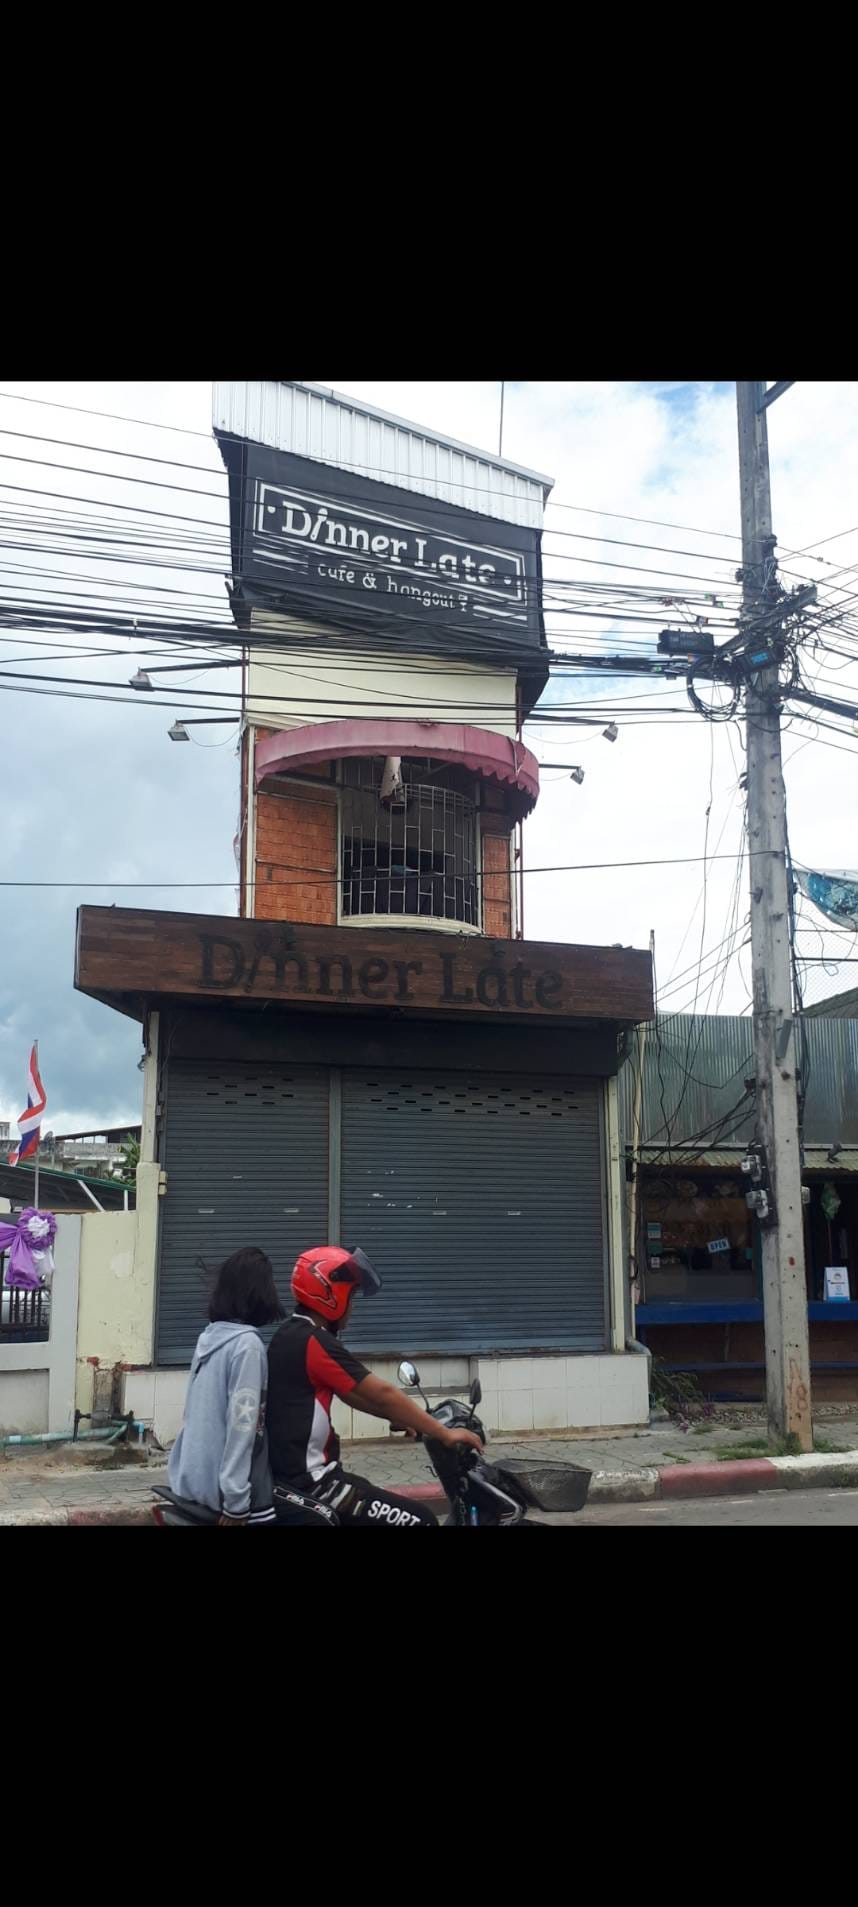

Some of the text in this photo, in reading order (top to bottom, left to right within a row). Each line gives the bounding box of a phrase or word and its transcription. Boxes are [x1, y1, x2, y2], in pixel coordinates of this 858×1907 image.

[282, 500, 496, 584] Dinner Late
[362, 572, 377, 589] &
[197, 927, 563, 1009] Dinner Late
[367, 1500, 421, 1526] SPORT
